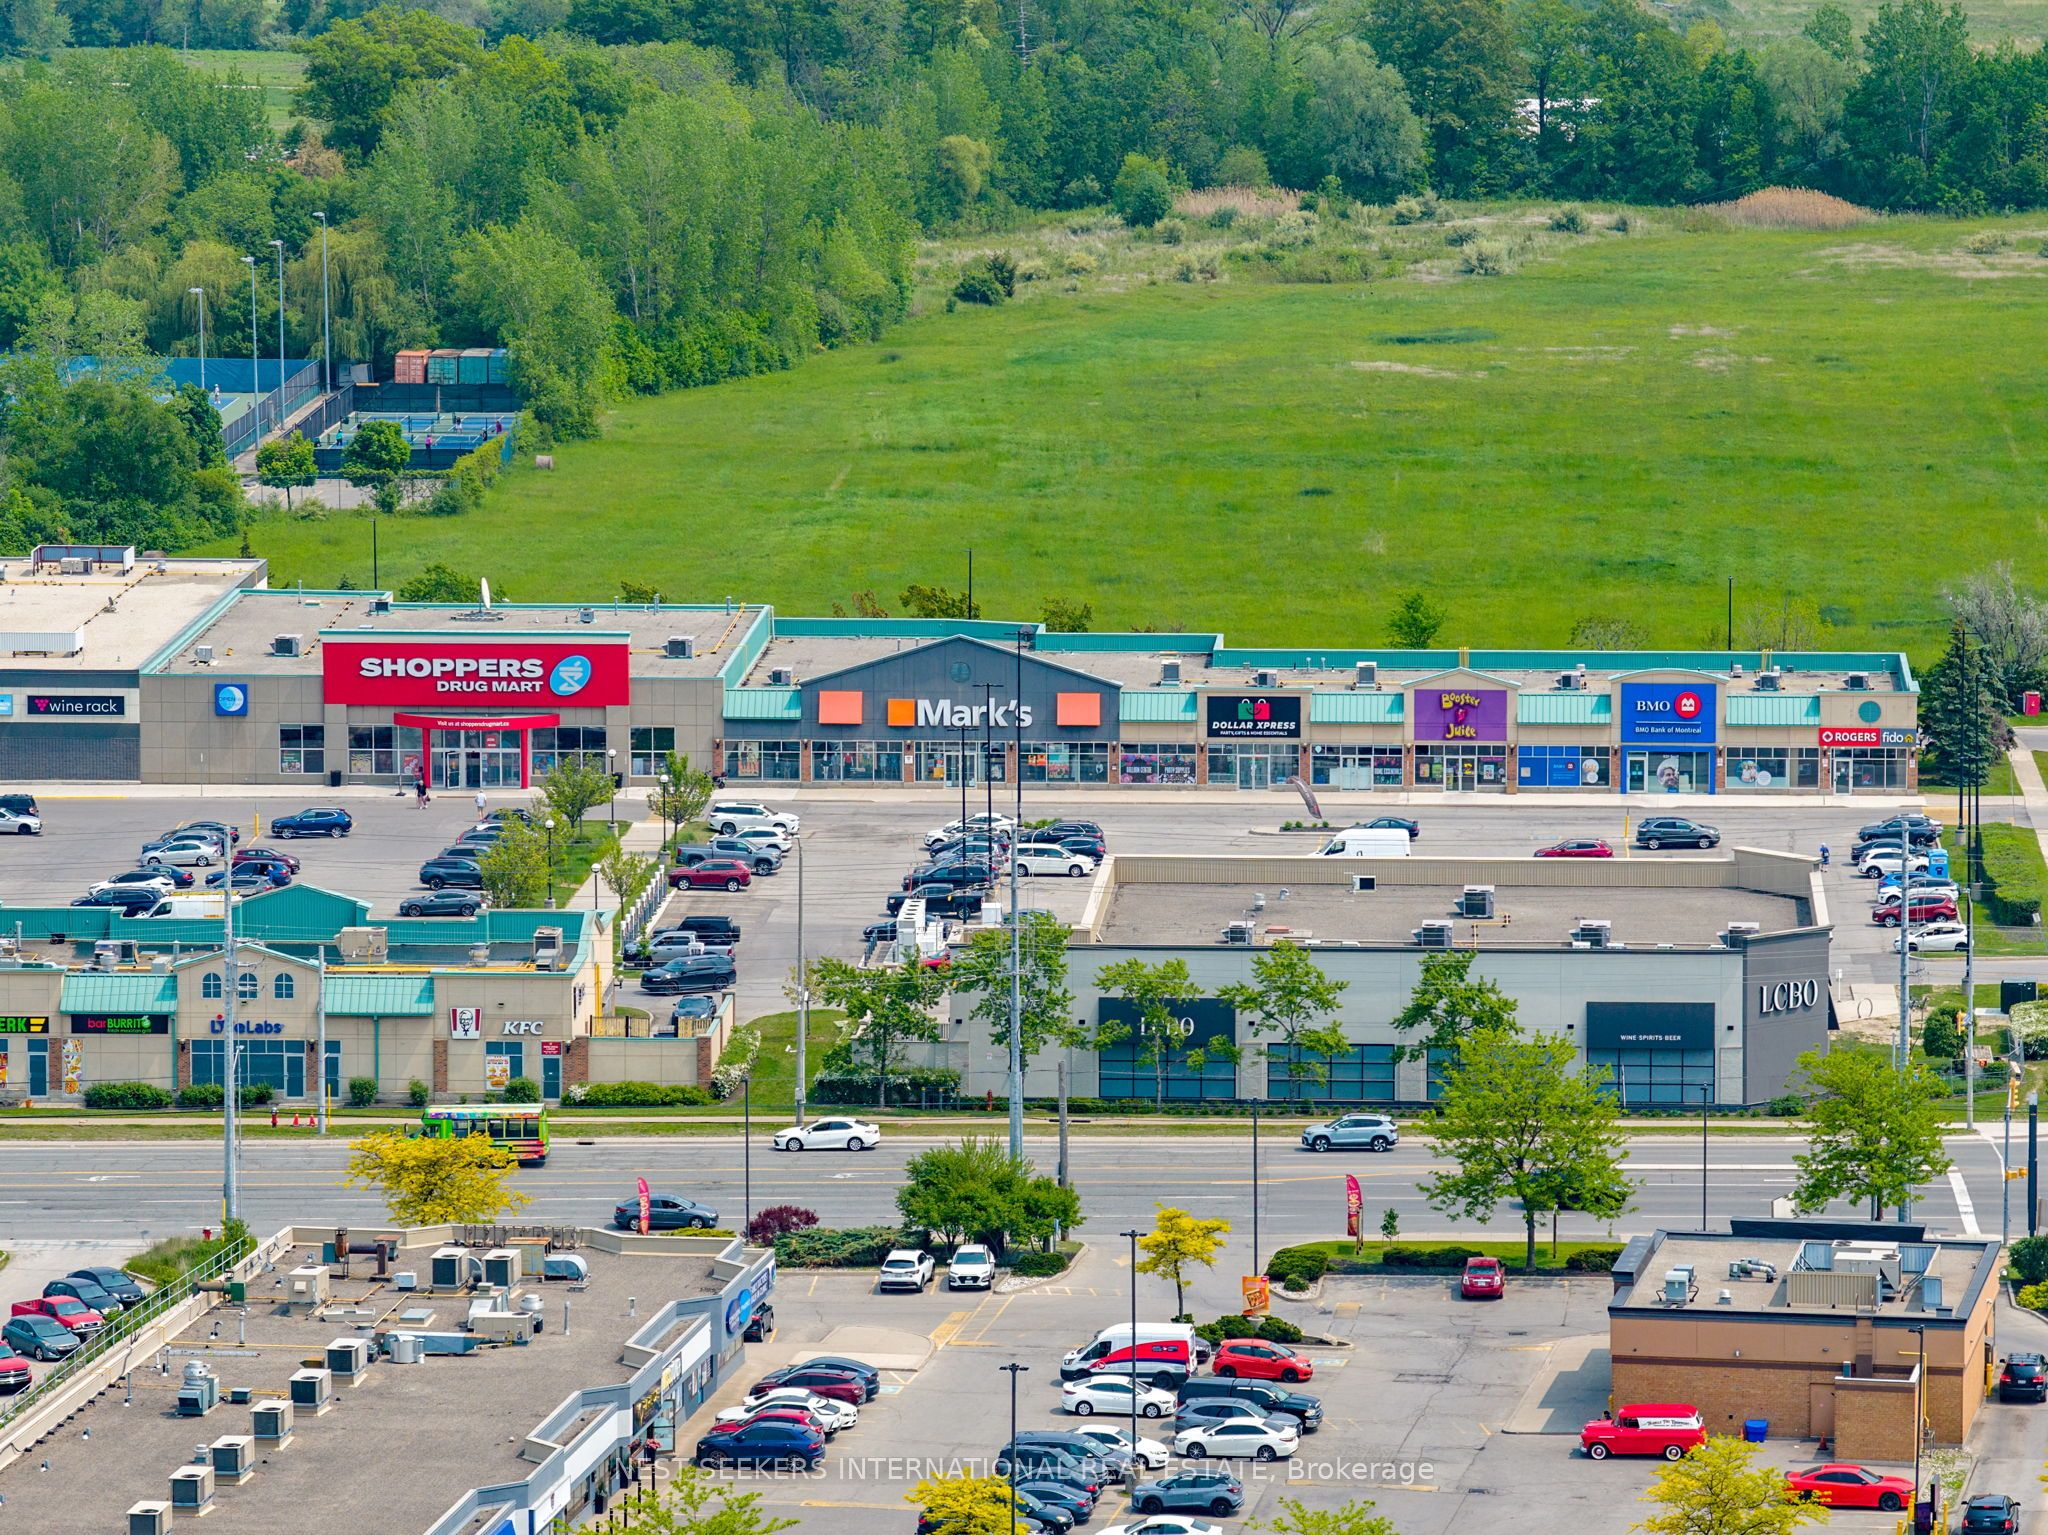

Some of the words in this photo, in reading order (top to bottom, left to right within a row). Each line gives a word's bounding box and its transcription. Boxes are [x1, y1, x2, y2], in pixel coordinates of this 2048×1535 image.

[359, 658, 544, 678] SHOPPERS
[436, 681, 488, 692] DRUG
[492, 681, 543, 692] MART
[49, 699, 83, 712] wine
[86, 698, 117, 712] rack
[1636, 700, 1670, 711] BMO
[917, 698, 1033, 728] Mark's
[1212, 721, 1253, 729] DOLLAR
[1256, 721, 1296, 730] XPRESS
[1445, 723, 1476, 739] Juice
[1835, 732, 1877, 742] ROGERS
[1882, 732, 1904, 743] fido
[1760, 978, 1818, 1014] LCBO
[503, 1021, 544, 1035] KFC
[1140, 1016, 1195, 1036] LO
